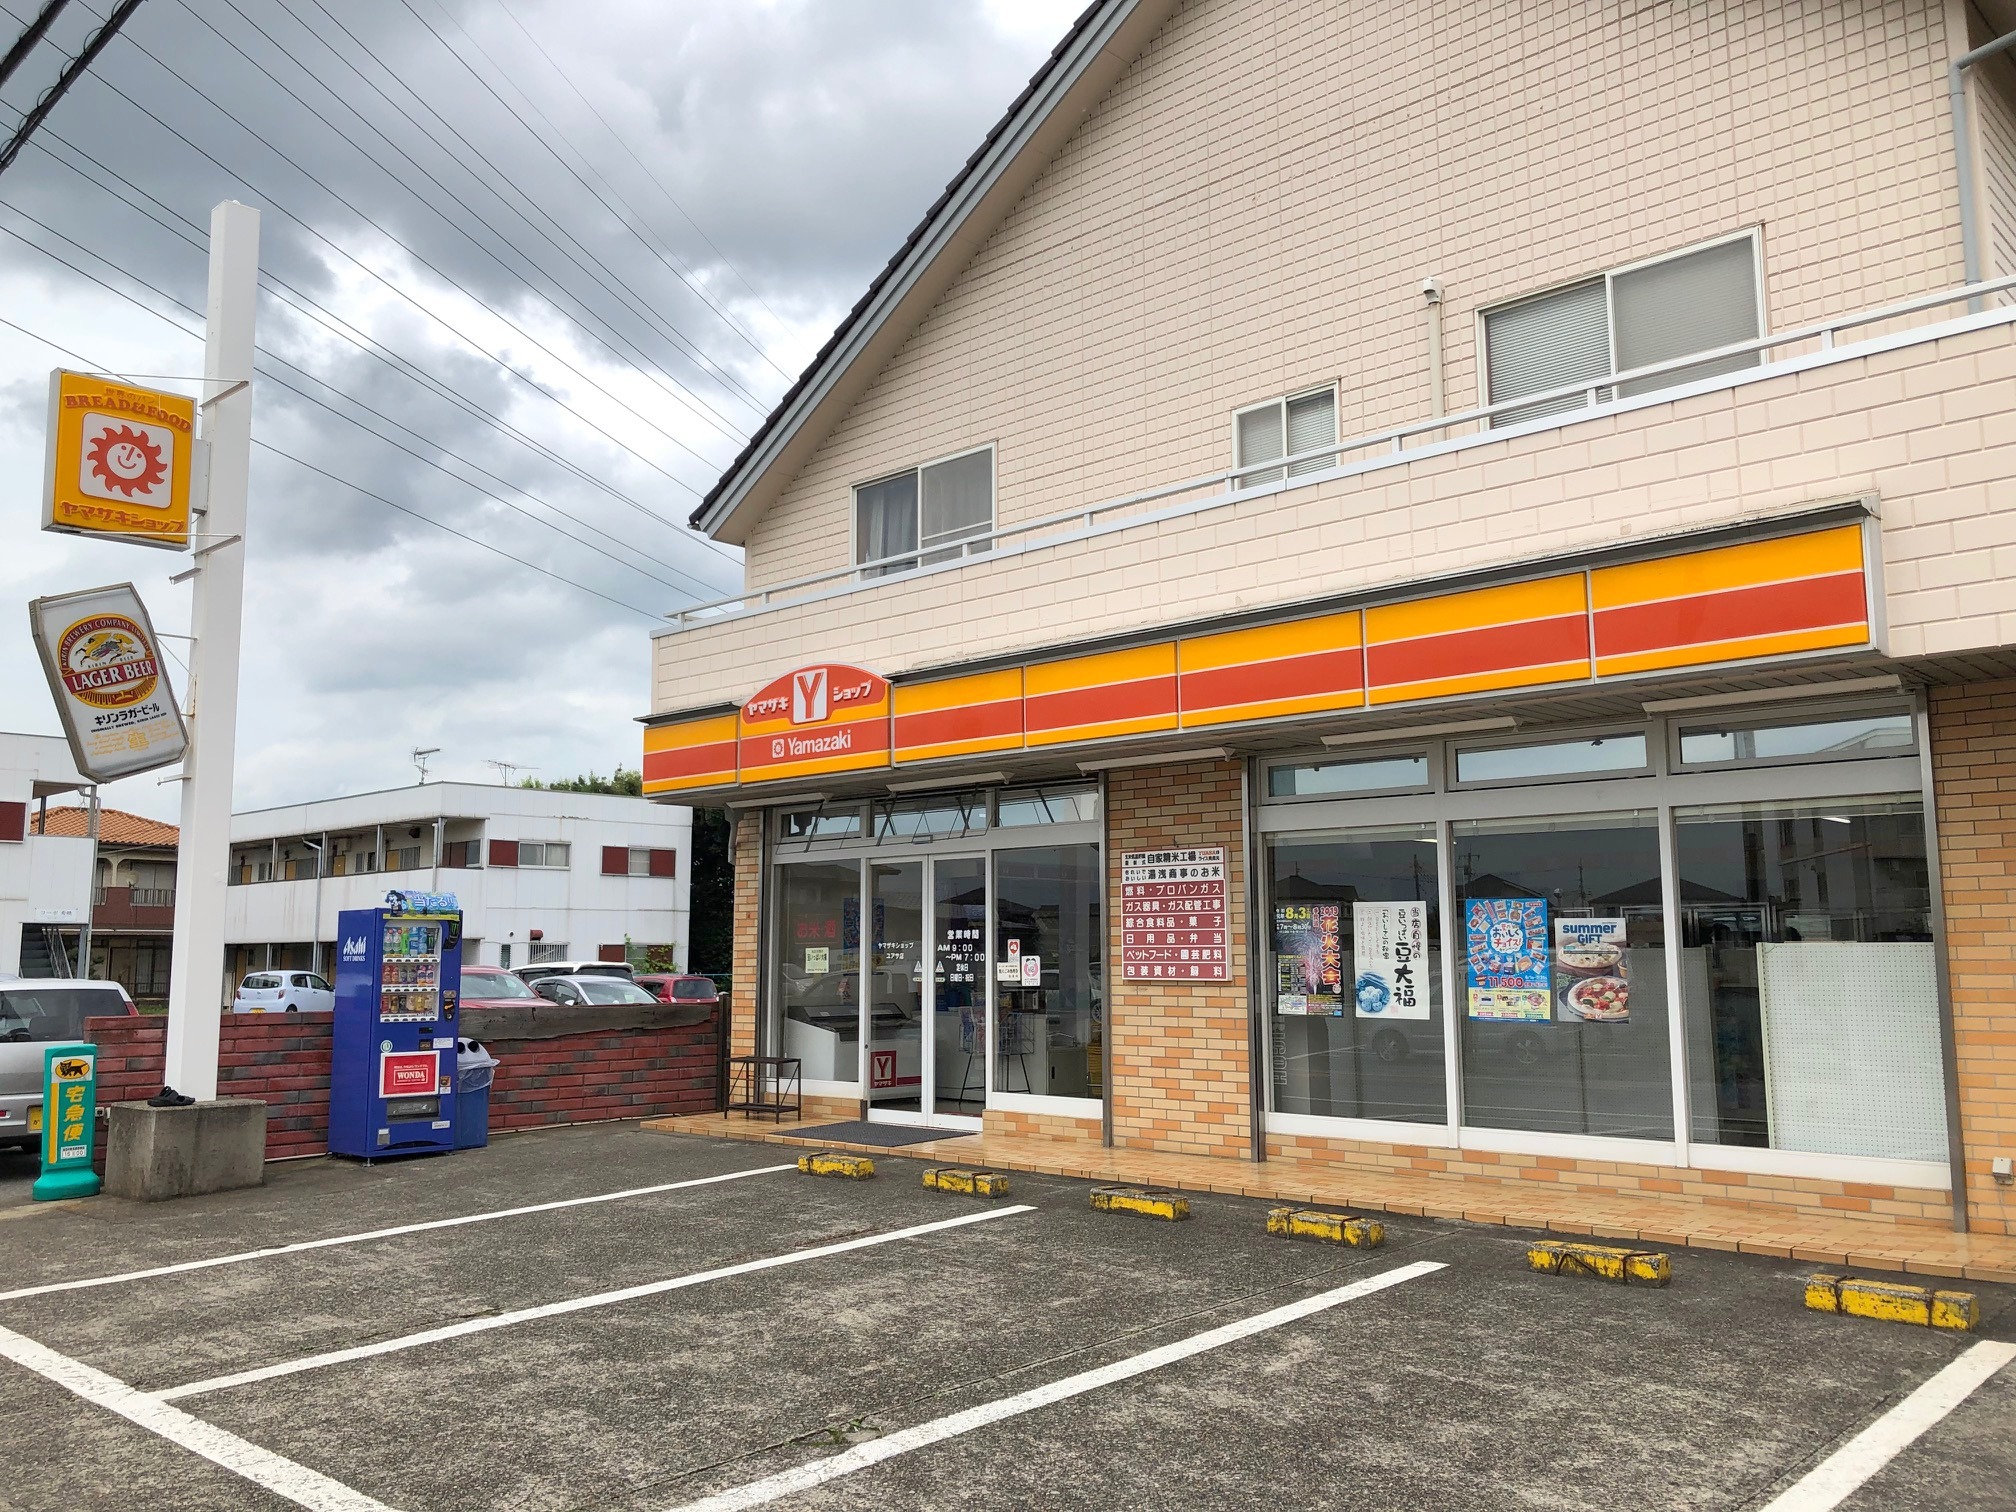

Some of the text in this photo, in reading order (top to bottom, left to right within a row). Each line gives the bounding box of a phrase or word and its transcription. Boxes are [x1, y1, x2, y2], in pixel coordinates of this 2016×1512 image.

[61, 501, 185, 533] ヤマザキショップ
[64, 622, 93, 647] BREWERY
[94, 619, 131, 631] COMPANY
[72, 660, 155, 692] LAGER BEER
[748, 672, 873, 720] ヤマザキ Y ショップ
[94, 703, 160, 726] キリンラガービール
[787, 730, 851, 756] Yamazaki
[1147, 850, 1197, 864] 自家精米工場
[1147, 866, 1221, 880] 湯浅商事のお米
[1125, 899, 1222, 913] ガス器具・ガス配管工事
[1320, 906, 1339, 916] 2019
[947, 929, 980, 940] 営業時間
[1492, 926, 1520, 938] おいしく
[1562, 924, 1617, 934] summer
[343, 936, 367, 955] Asahi
[1126, 933, 1222, 945] 日用品・弁当
[1577, 933, 1603, 944] GIFT
[877, 942, 914, 950] ヤマザキショップ
[937, 943, 973, 952] AM 9:00
[1320, 915, 1341, 985] 花火大会
[964, 953, 985, 962] 7:00
[1126, 949, 1223, 961] ペットフード・園芸肥料
[955, 963, 969, 972] 定休日
[1127, 965, 1223, 978] 包装資材・飼料
[1393, 941, 1417, 1008] 豆大福
[397, 1070, 426, 1080] WONDA
[876, 1057, 891, 1079] Y
[63, 1085, 86, 1142] 宅急便
